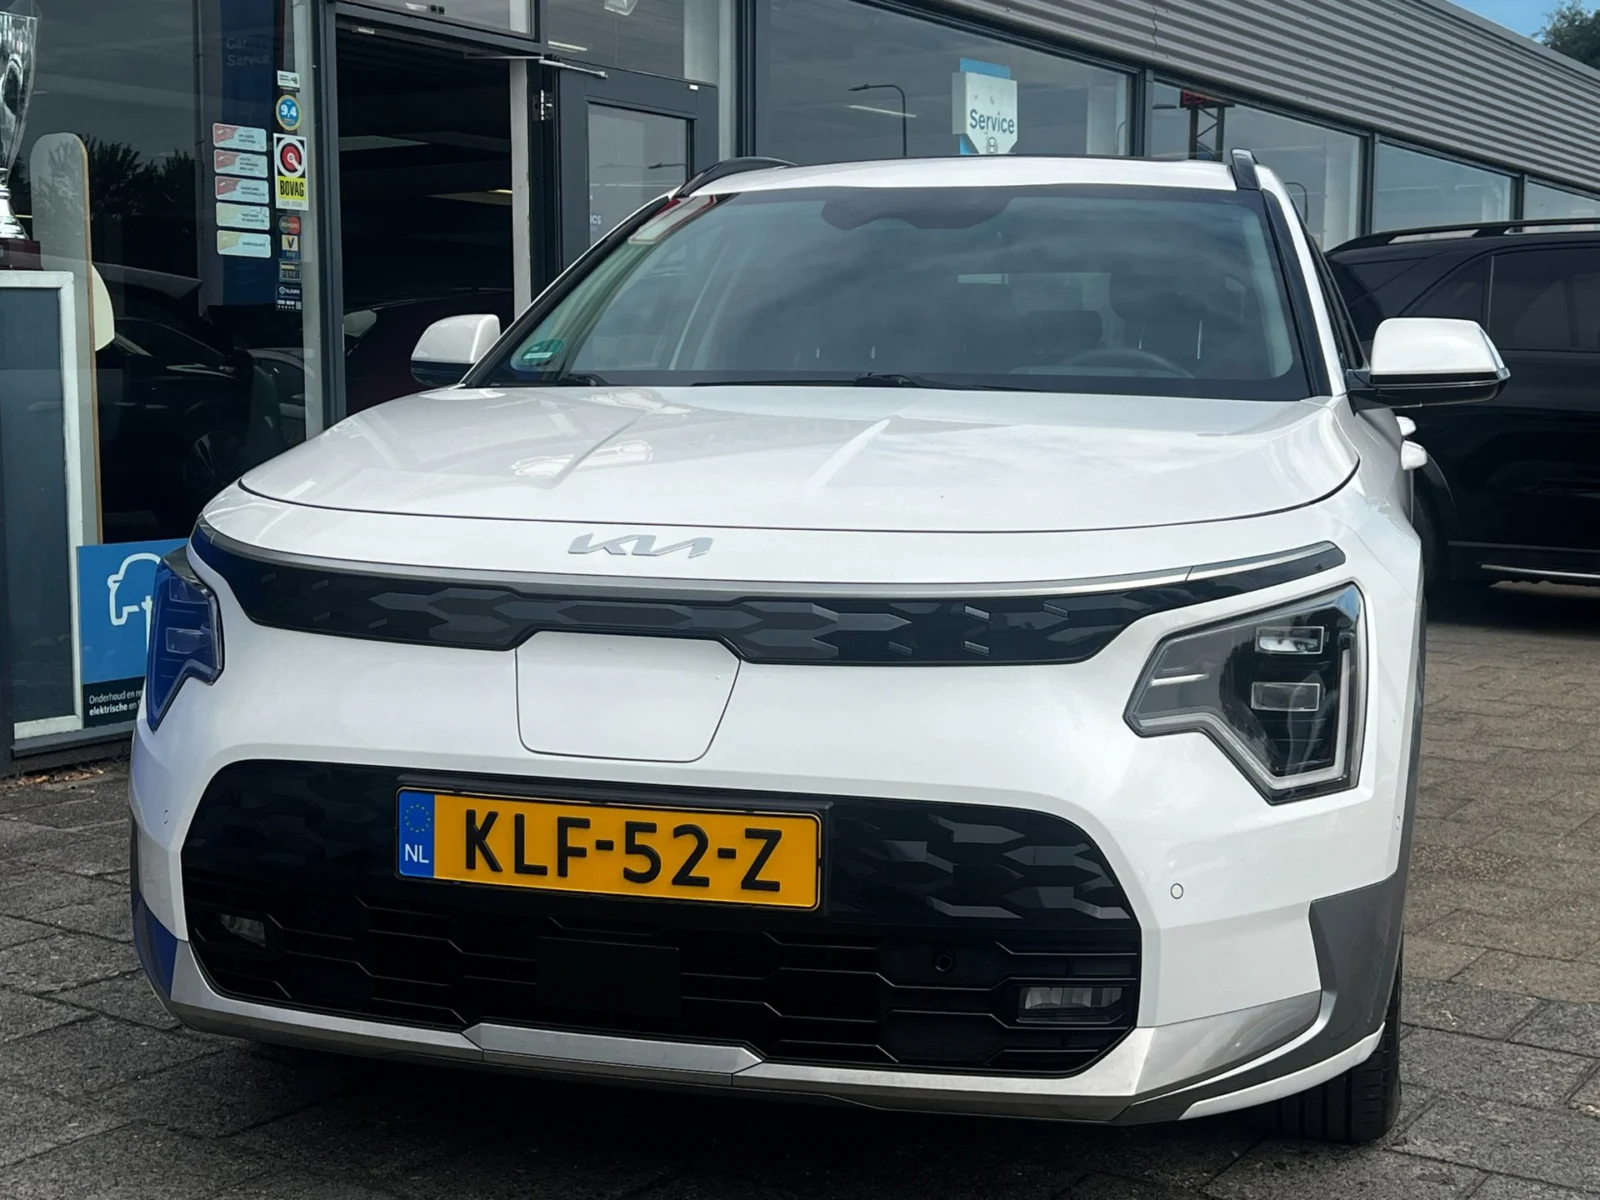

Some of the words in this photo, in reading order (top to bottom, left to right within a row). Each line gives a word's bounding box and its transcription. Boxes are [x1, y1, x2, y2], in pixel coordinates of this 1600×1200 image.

[280, 104, 297, 118] 9,4
[969, 108, 1015, 135] Service
[280, 180, 304, 197] BOVAG
[89, 690, 126, 705] Onderhoud
[126, 690, 136, 699] en
[89, 702, 128, 716] elektrische
[129, 702, 138, 710] en
[404, 844, 430, 864] NL
[465, 809, 783, 893] KLF-52-Z
